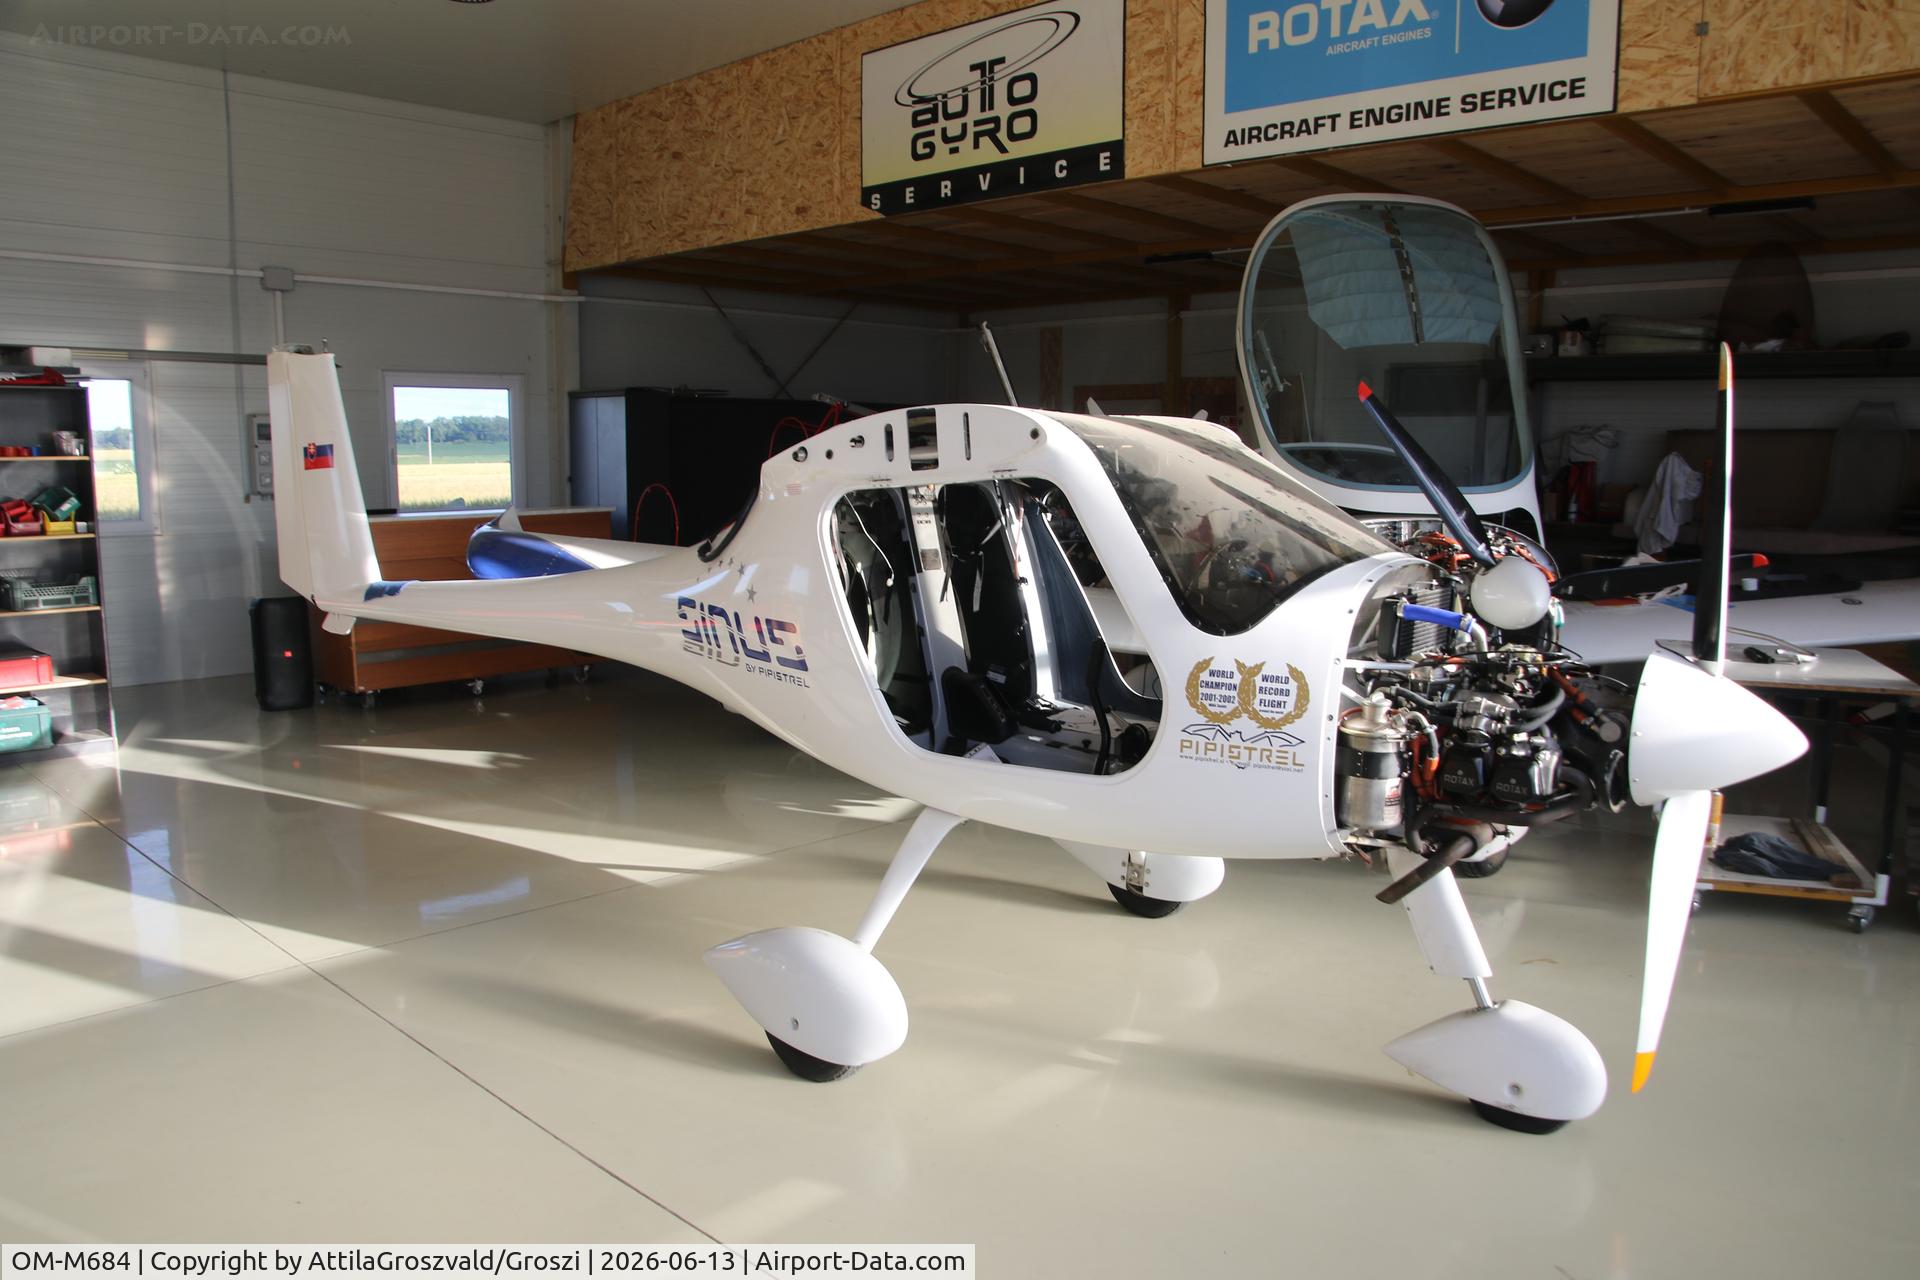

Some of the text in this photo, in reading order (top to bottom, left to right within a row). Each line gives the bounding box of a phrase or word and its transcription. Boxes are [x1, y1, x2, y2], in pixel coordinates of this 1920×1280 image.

[1248, 0, 1430, 54] ROTAX
[1326, 27, 1432, 56] AIRCRAFT ENGINES
[1223, 77, 1586, 148] AIRCRAFT ENGINE SERVICE
[911, 108, 1038, 162] GYRO
[870, 152, 1111, 210] SERVICE
[758, 666, 810, 688] PIPISTREL
[1208, 668, 1234, 680] WORLD
[1261, 674, 1290, 685] WORLD
[1199, 681, 1237, 692] CHAMPION
[1258, 686, 1290, 697] RECORD
[1200, 692, 1236, 704] 2001-2002
[1259, 698, 1287, 709] FLIGHT
[1180, 739, 1305, 767] PIPISTREL
[1443, 774, 1475, 787] ROTAX
[1496, 782, 1528, 795] ROTAX
